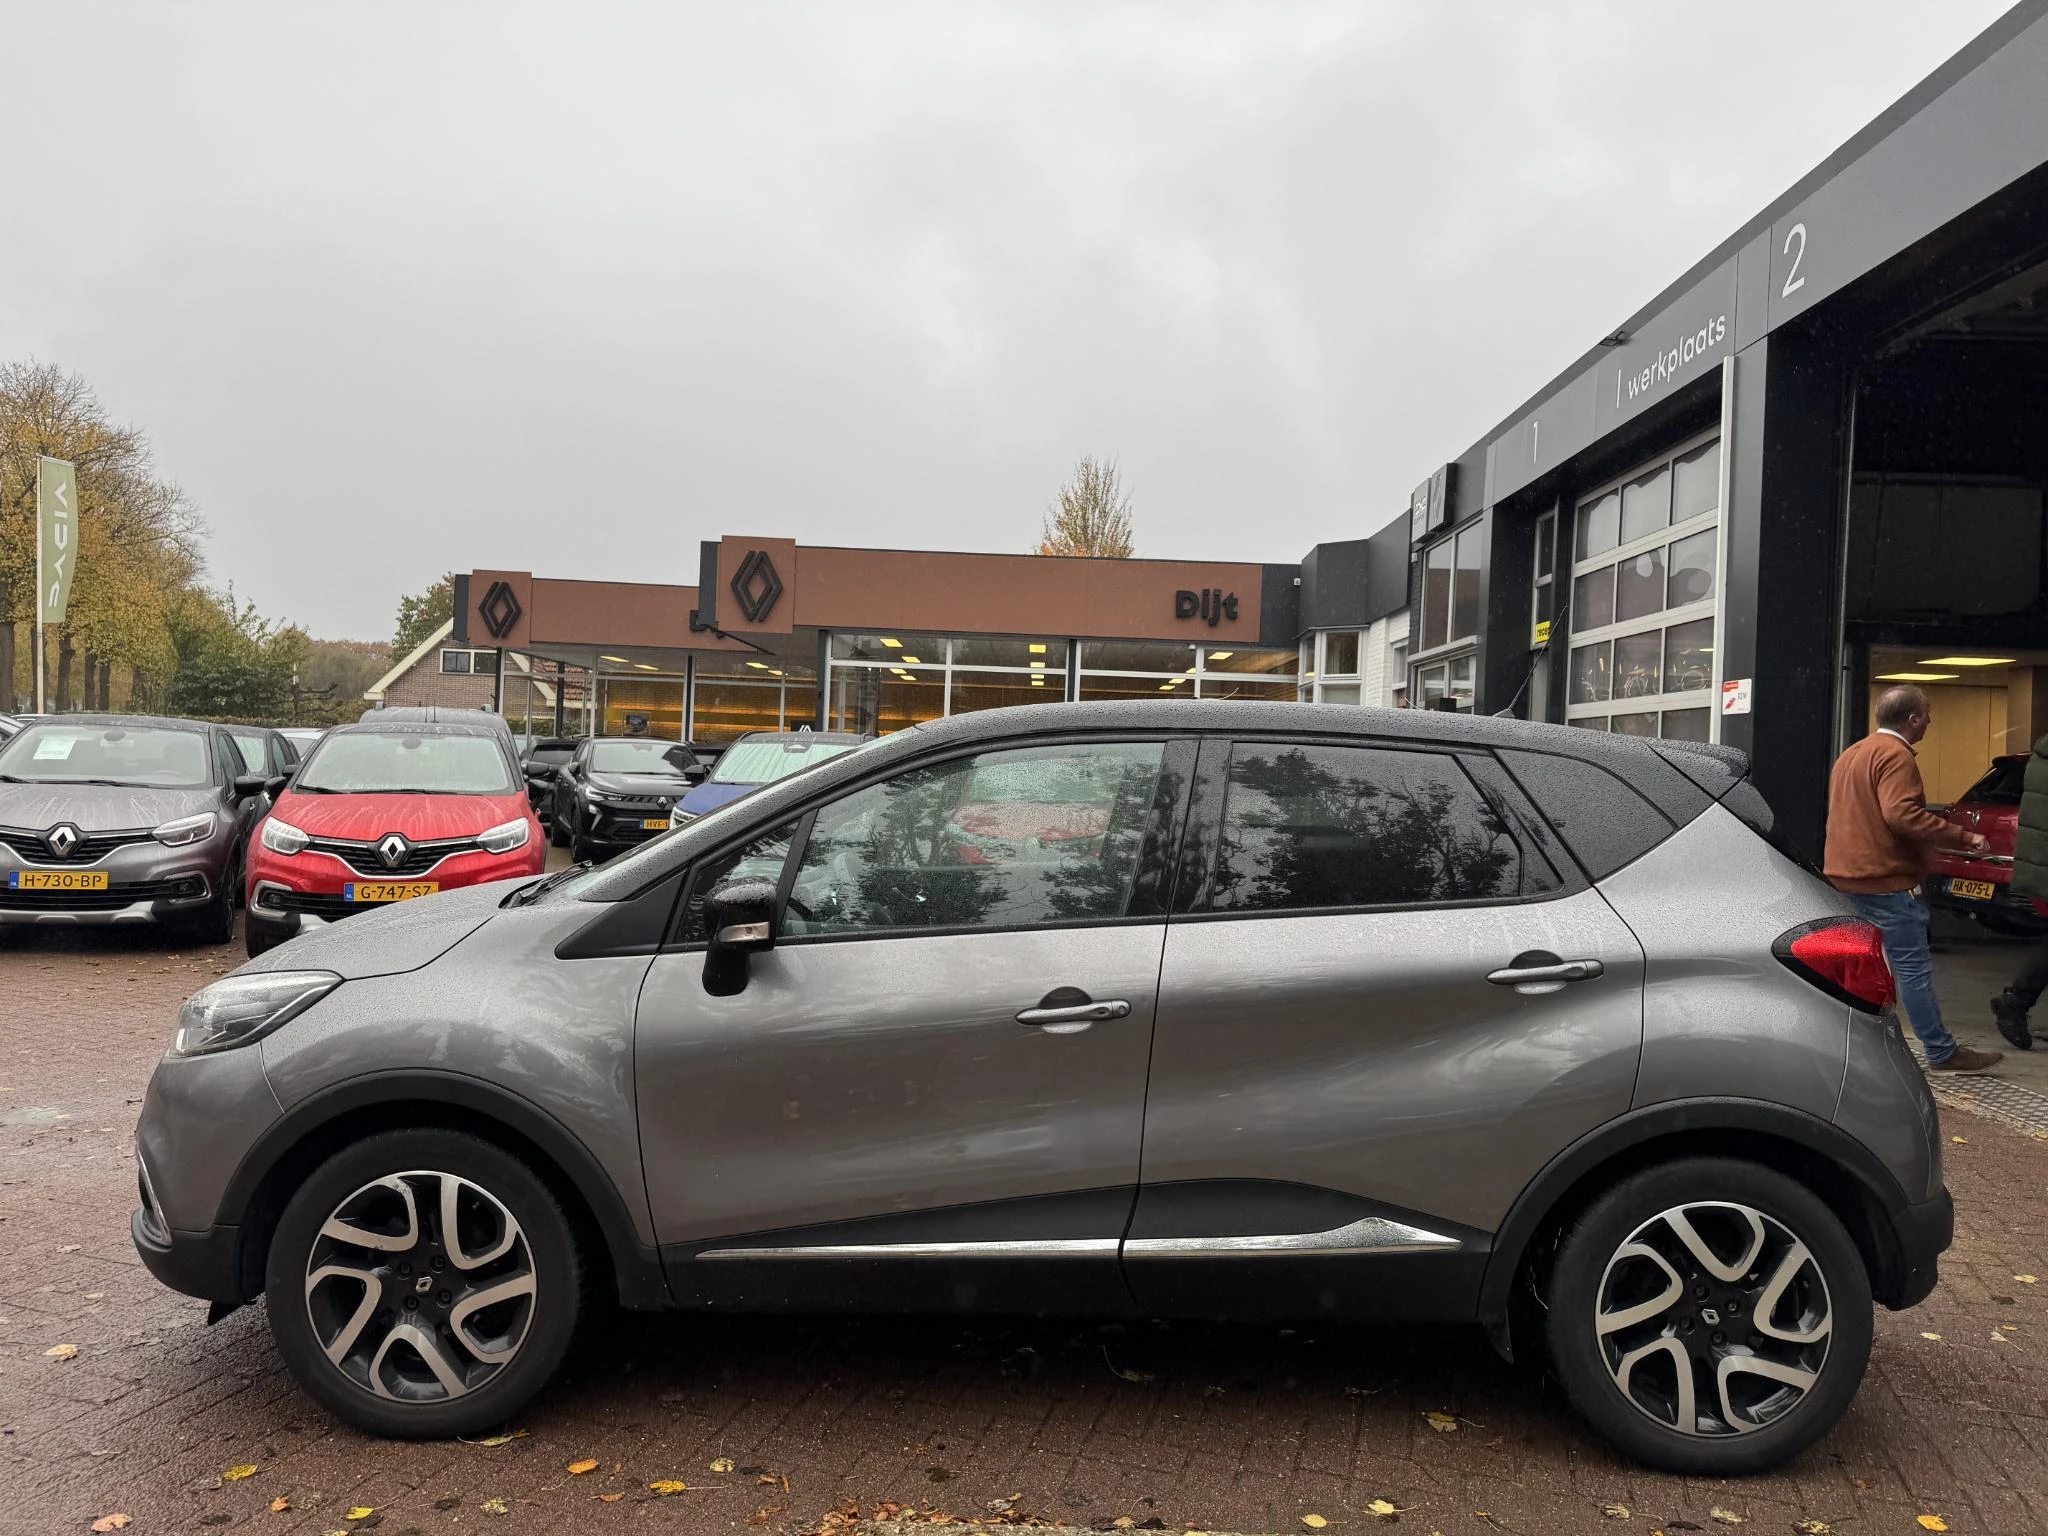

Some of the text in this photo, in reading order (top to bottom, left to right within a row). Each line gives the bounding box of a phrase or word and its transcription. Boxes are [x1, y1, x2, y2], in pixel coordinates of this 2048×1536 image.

[1782, 223, 1807, 299] 2
[1627, 314, 1726, 400] werkplaats
[1532, 421, 1539, 464] 1
[48, 481, 68, 607] DACIA
[1176, 588, 1239, 626] Dijt
[24, 874, 102, 888] H-730-BP
[1952, 879, 1991, 897] HK-075-L
